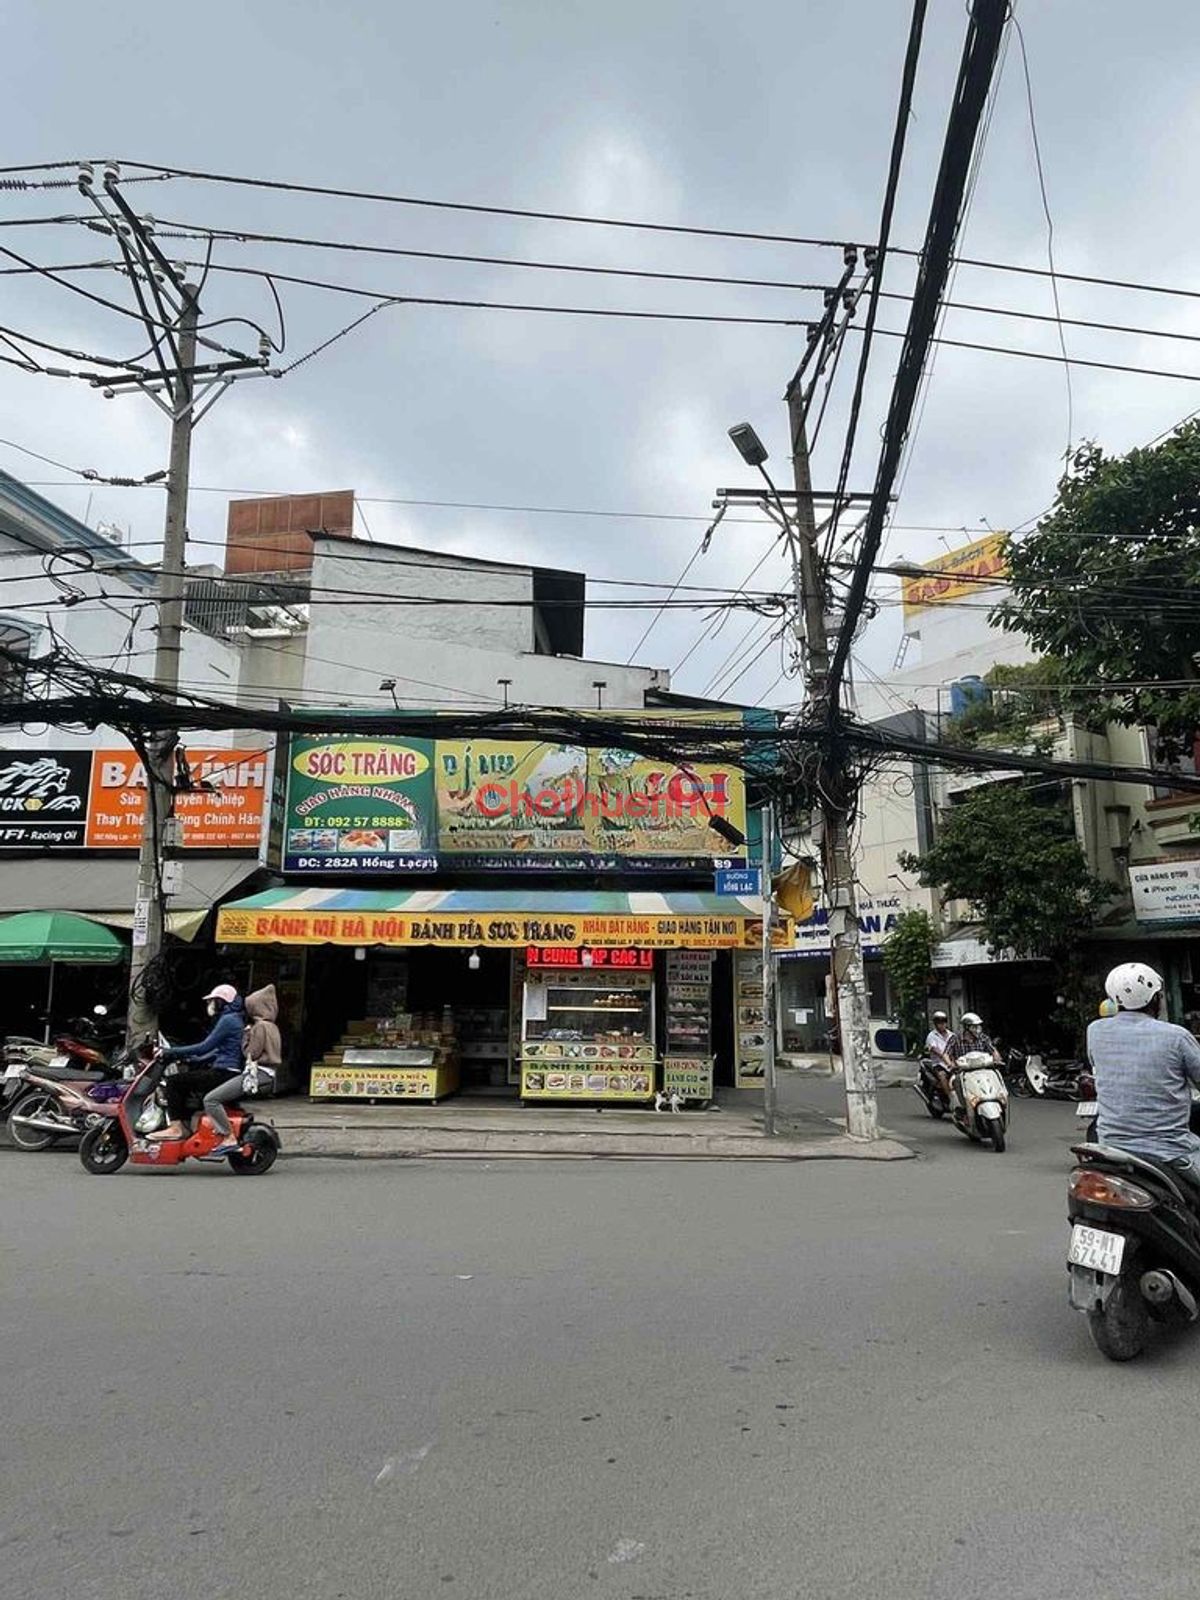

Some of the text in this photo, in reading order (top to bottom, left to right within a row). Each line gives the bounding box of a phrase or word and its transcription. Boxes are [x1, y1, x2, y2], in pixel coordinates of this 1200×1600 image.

[307, 746, 346, 776] SÓC
[351, 747, 416, 776] TRĂNG
[0, 797, 25, 811] CK
[295, 792, 328, 816] GIAO
[327, 783, 372, 800] HÀNG
[96, 812, 122, 828] Thay
[204, 811, 236, 825] Chính
[327, 816, 352, 827] 092
[353, 816, 369, 827] 57
[30, 830, 62, 842] Racing
[63, 830, 78, 841] Oil
[298, 857, 320, 867] ĐC:
[324, 857, 359, 868] 282A
[362, 856, 395, 869] Hồng
[256, 915, 307, 936] BÁNH
[312, 915, 337, 938] MÌ
[341, 916, 366, 938] HÀ
[371, 916, 405, 941] NỘI
[410, 918, 456, 939] BÁNH
[626, 918, 650, 934] HÀNG
[657, 920, 677, 934] GIAO
[678, 917, 702, 935] HÀNG
[703, 917, 720, 938] TẬN
[542, 948, 578, 963] CUNG
[611, 948, 637, 965] CÁC
